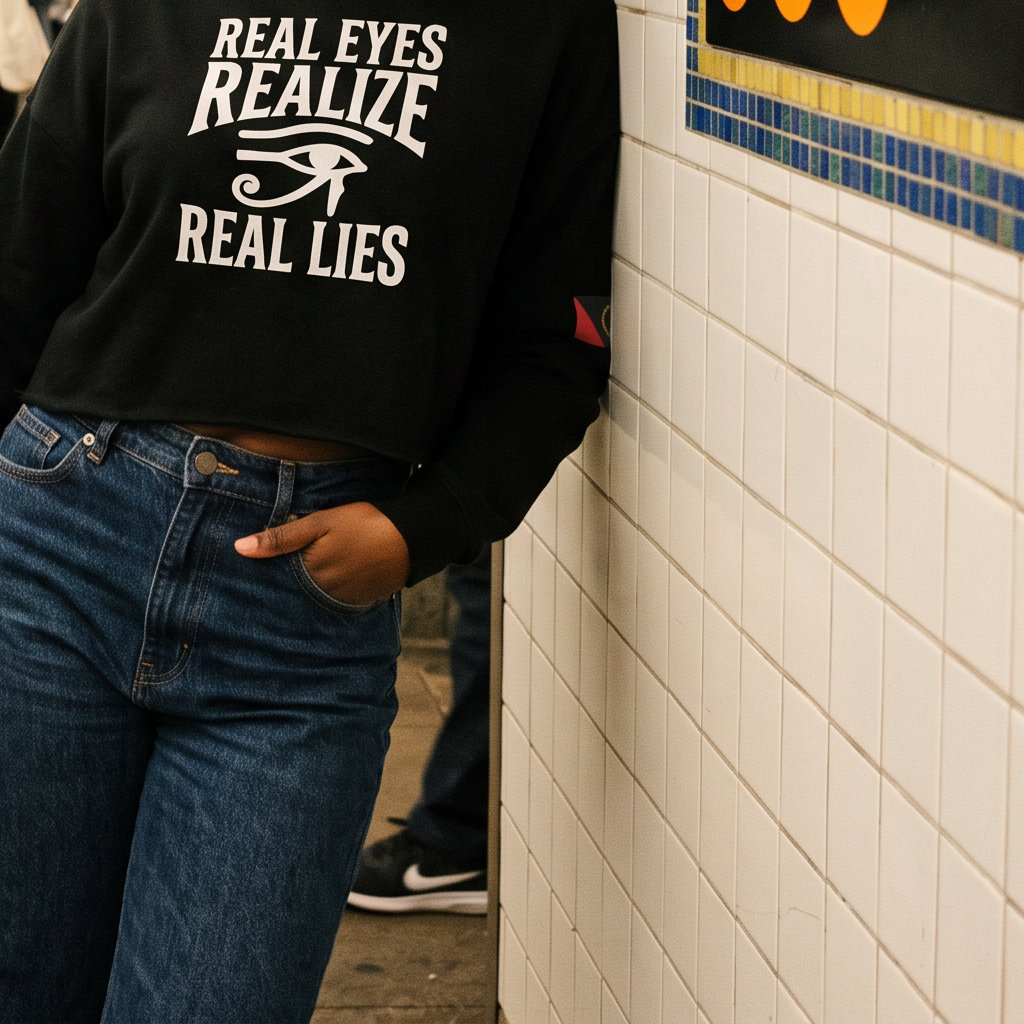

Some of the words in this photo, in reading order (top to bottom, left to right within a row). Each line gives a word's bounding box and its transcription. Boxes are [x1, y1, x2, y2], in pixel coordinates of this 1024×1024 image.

[209, 16, 321, 61] REAL
[333, 18, 448, 71] EYES
[187, 61, 439, 159] REALIZE
[175, 203, 293, 273] REAL
[306, 220, 409, 287] LIES
